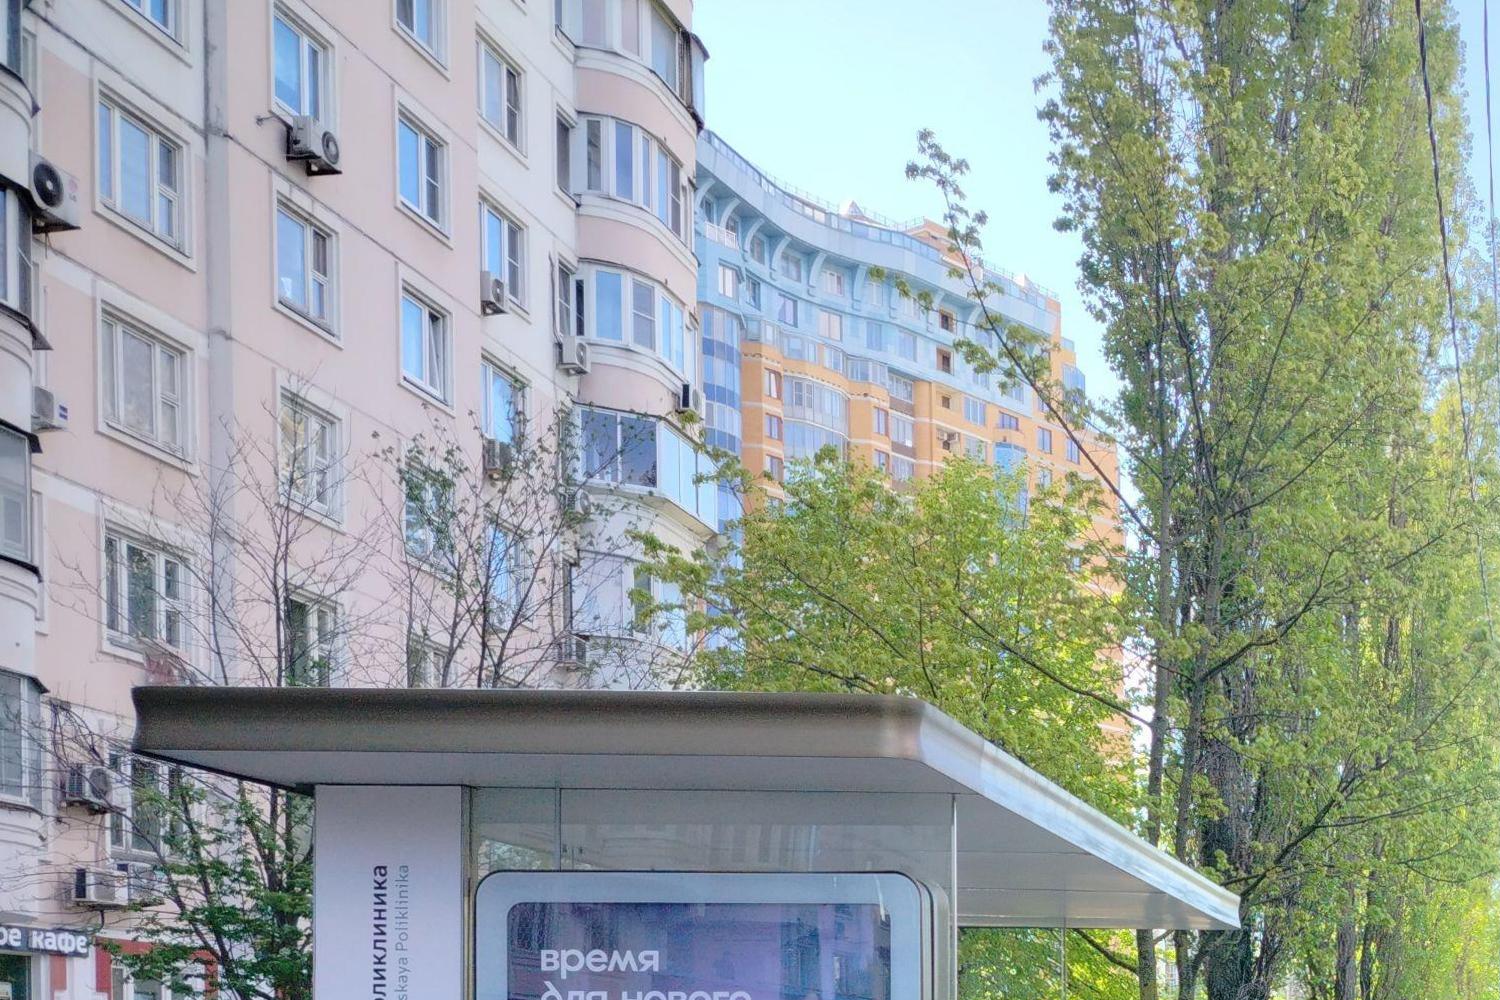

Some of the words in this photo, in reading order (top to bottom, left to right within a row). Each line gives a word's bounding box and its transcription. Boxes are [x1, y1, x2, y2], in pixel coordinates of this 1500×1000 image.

[394, 864, 409, 952] Poliklinika
[32, 930, 88, 954] кафе
[540, 949, 660, 979] время
